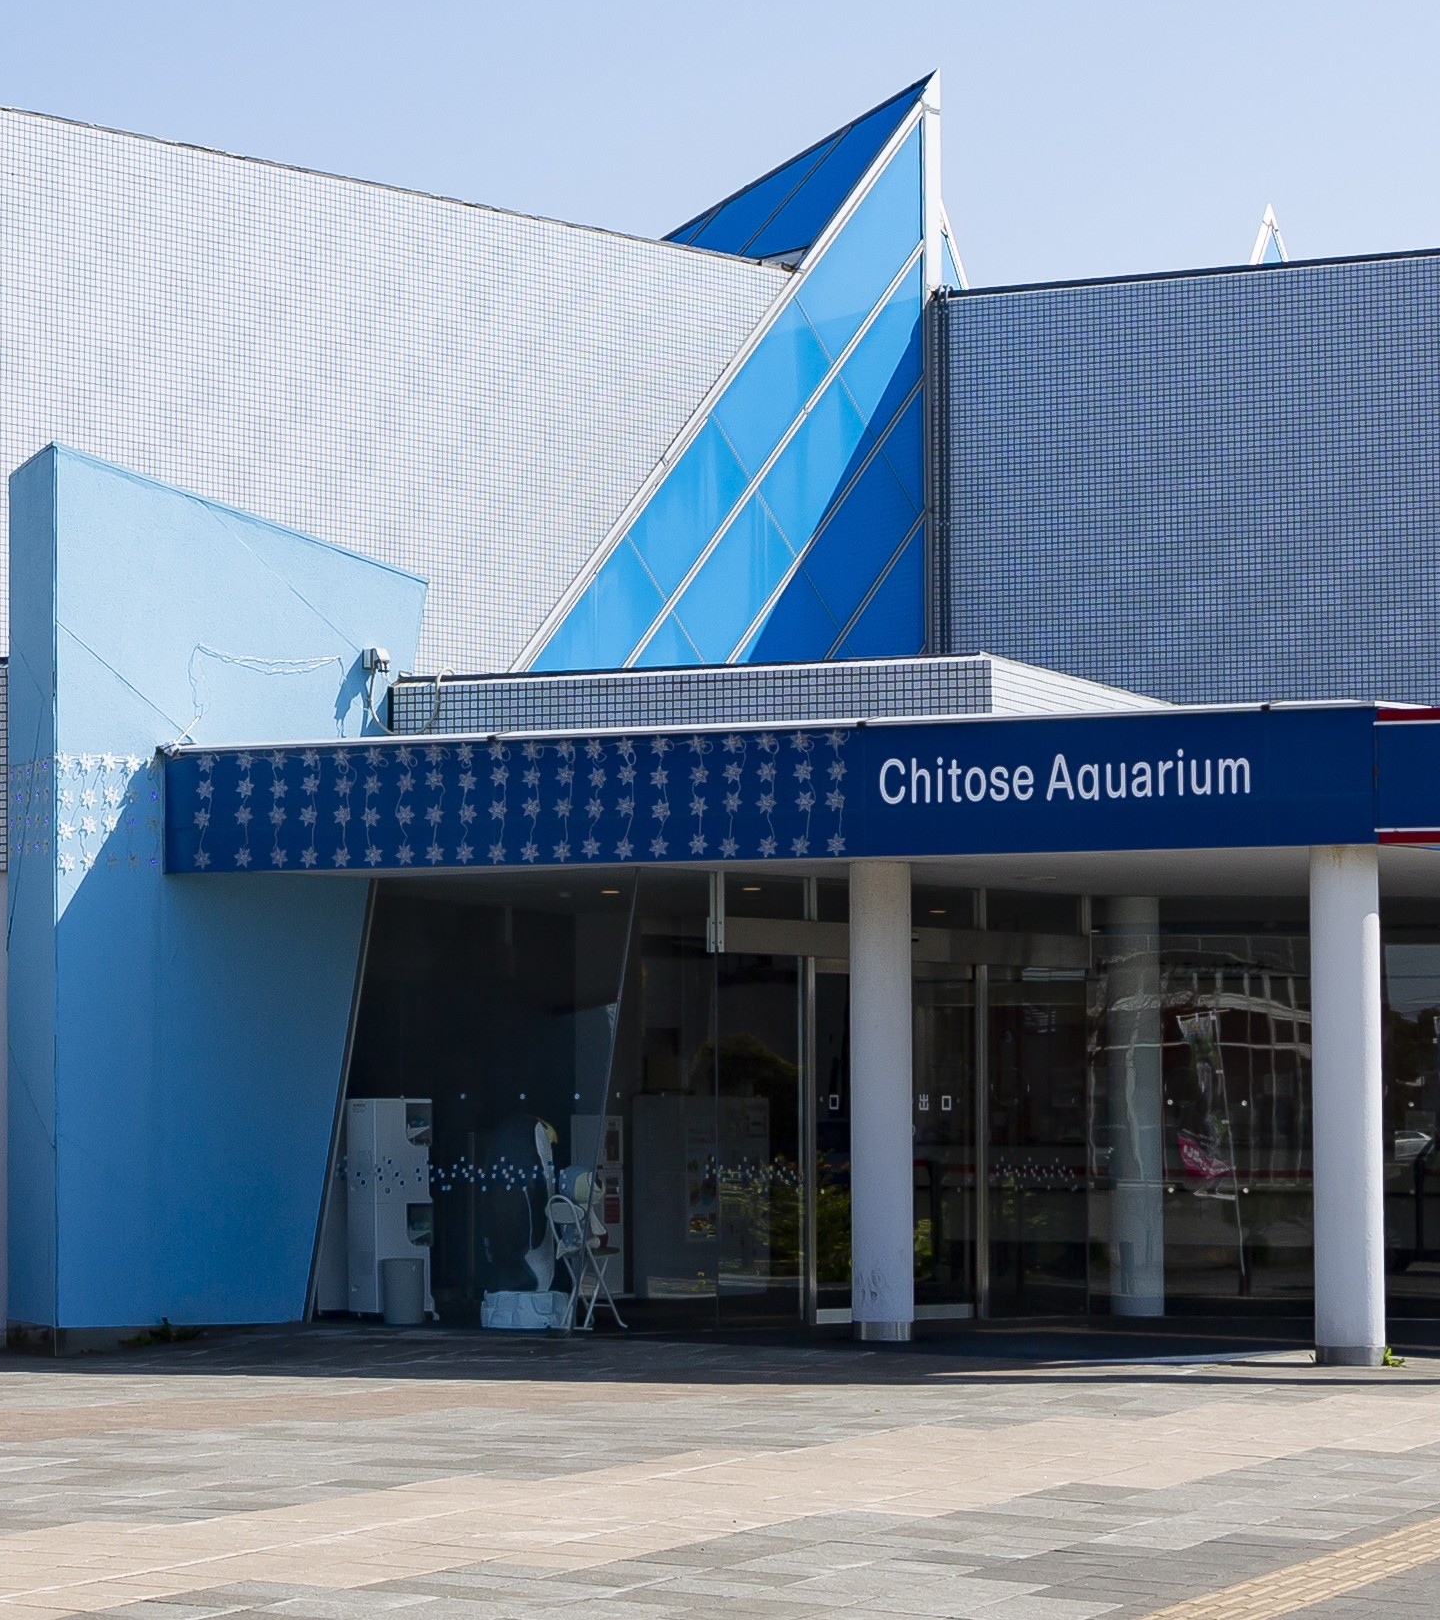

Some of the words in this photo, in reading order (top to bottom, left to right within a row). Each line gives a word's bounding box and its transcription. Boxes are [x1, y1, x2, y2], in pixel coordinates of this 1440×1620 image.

[879, 756, 1034, 805] Chitose
[1046, 748, 1252, 803] Aquarium
[918, 1093, 952, 1111] 出口
